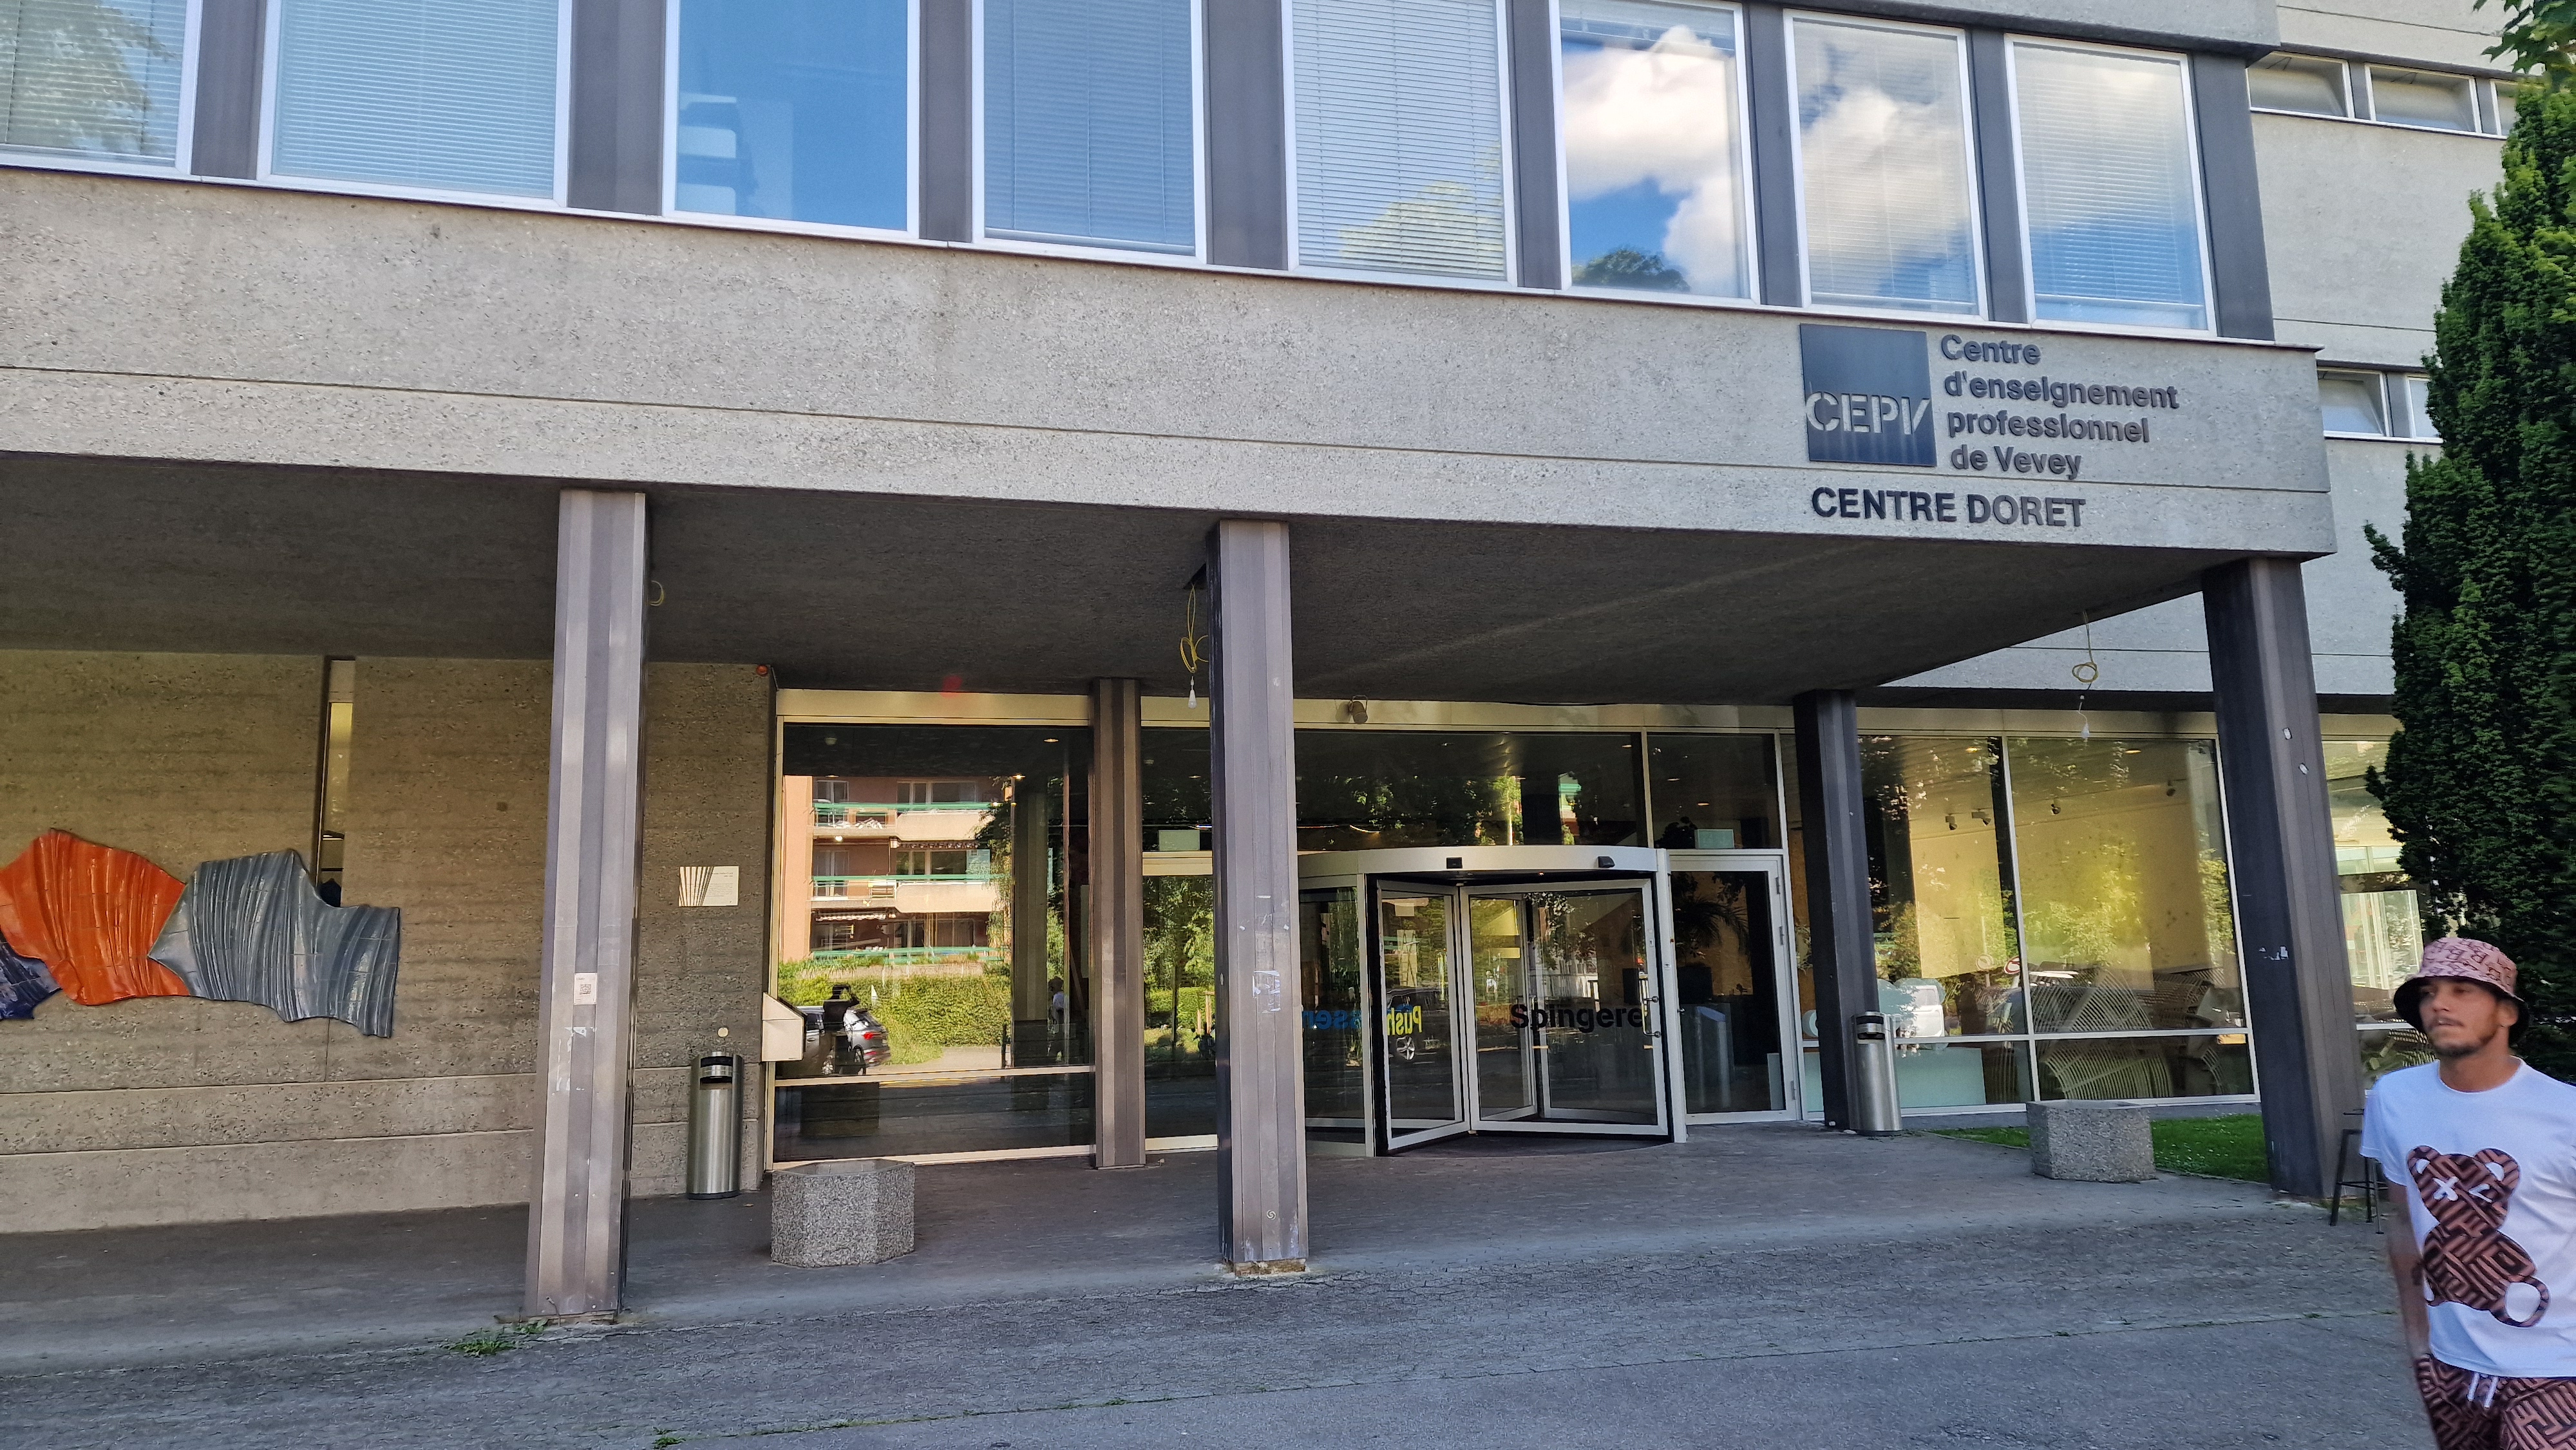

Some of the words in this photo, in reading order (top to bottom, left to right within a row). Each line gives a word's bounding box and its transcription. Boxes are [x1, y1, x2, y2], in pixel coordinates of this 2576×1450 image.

[1941, 334, 2041, 365] Centre
[1944, 370, 2179, 409] d'enseignement
[1805, 391, 1931, 435] CEPV
[1947, 410, 2150, 443] professionnel
[1951, 444, 1988, 471] de
[1994, 446, 2082, 480] Vevey
[1812, 487, 1958, 522] CENTRE
[1967, 494, 2087, 527] DORET
[1510, 1004, 1643, 1033] Spingere
